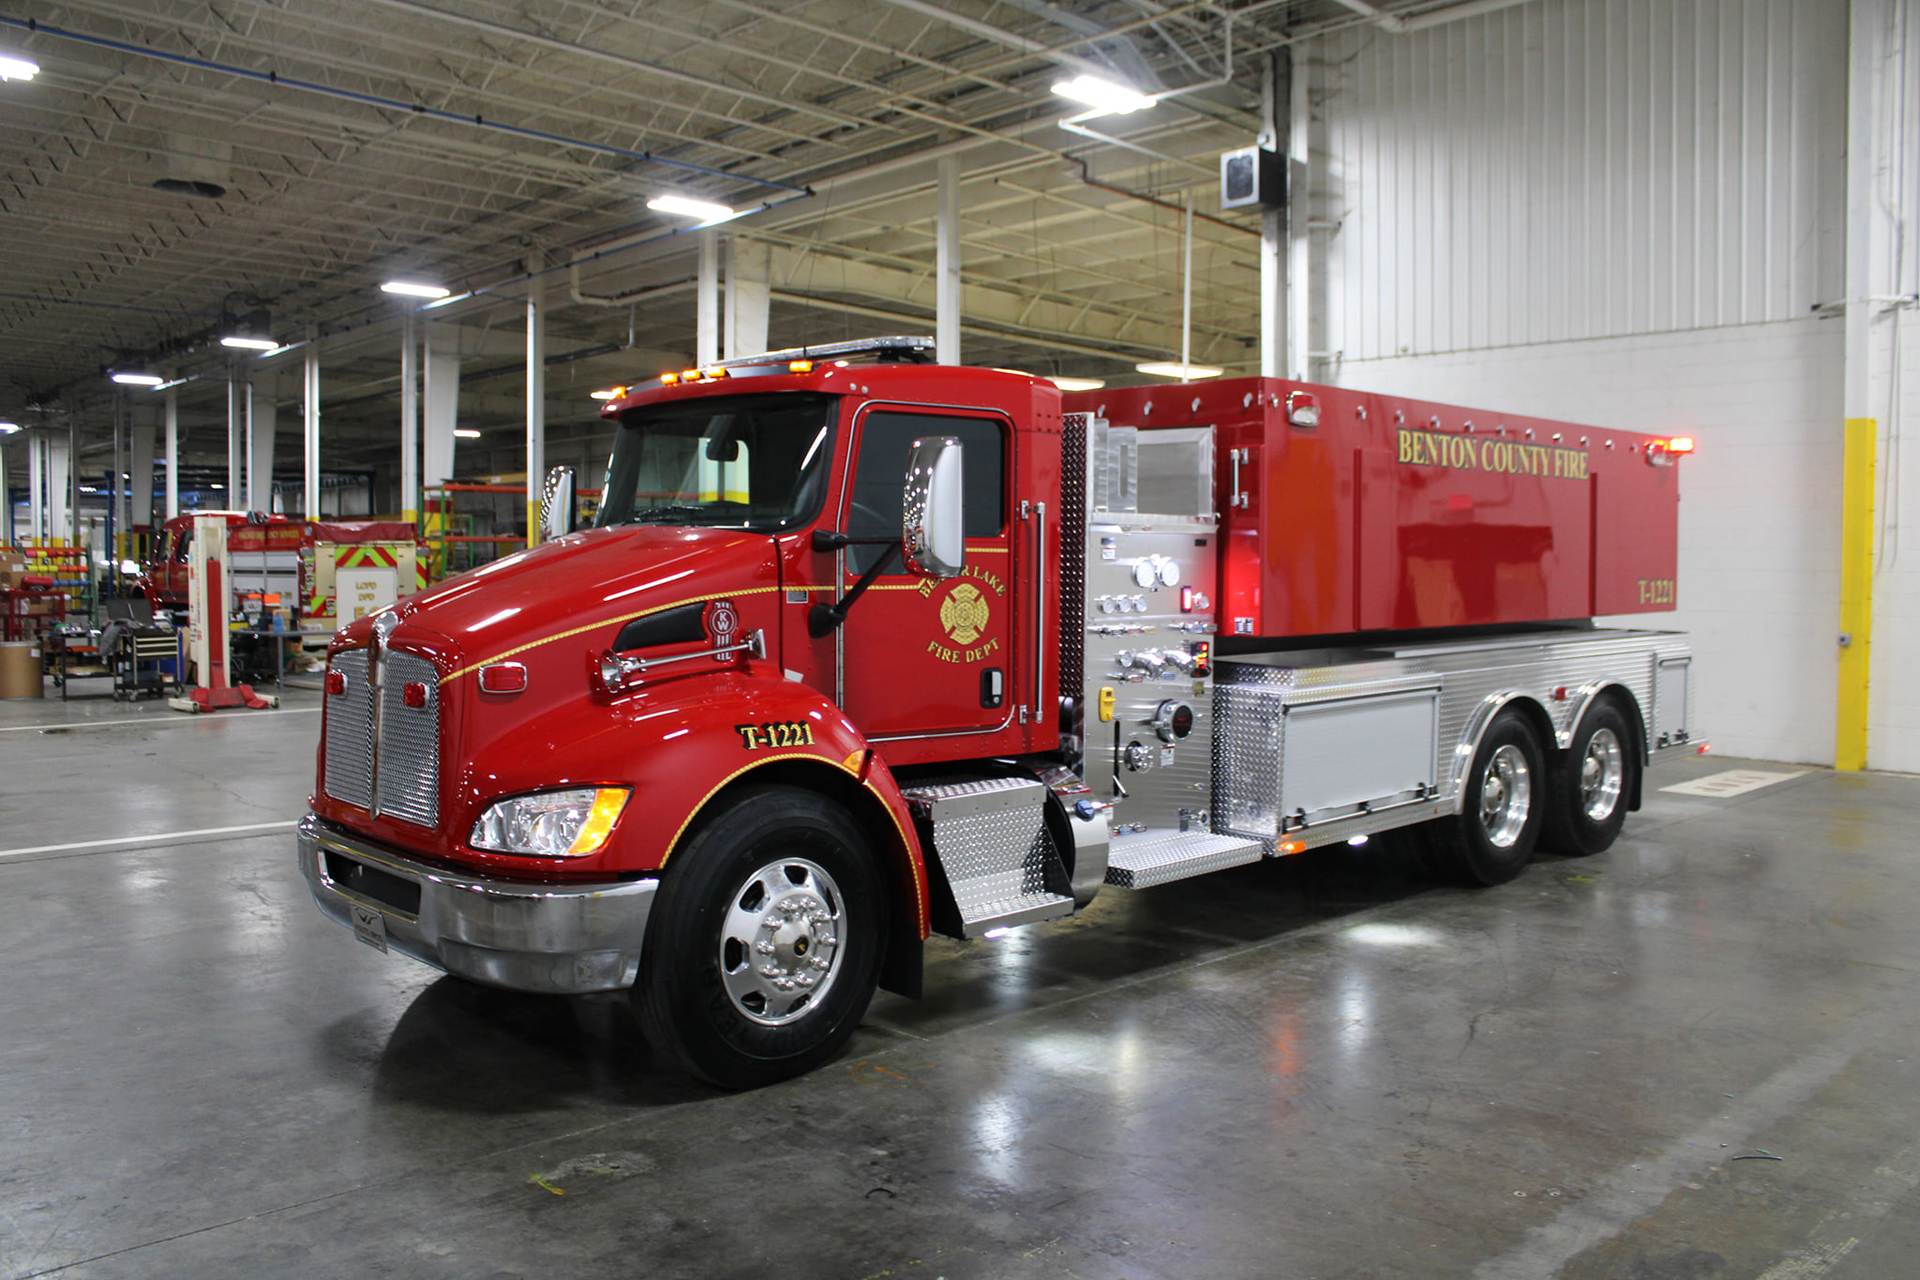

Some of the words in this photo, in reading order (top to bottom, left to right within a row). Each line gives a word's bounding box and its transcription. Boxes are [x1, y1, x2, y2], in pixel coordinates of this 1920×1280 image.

[1398, 428, 1477, 470] BENTON
[1480, 438, 1550, 477] COUNTY
[1553, 447, 1590, 480] FIRE
[973, 565, 1007, 597] LAKE
[1637, 578, 1674, 605] T-1221
[717, 620, 730, 631] W
[719, 612, 728, 621] K
[926, 640, 961, 664] FIRE
[965, 637, 999, 663] DEPT
[735, 720, 815, 750] T-1221
